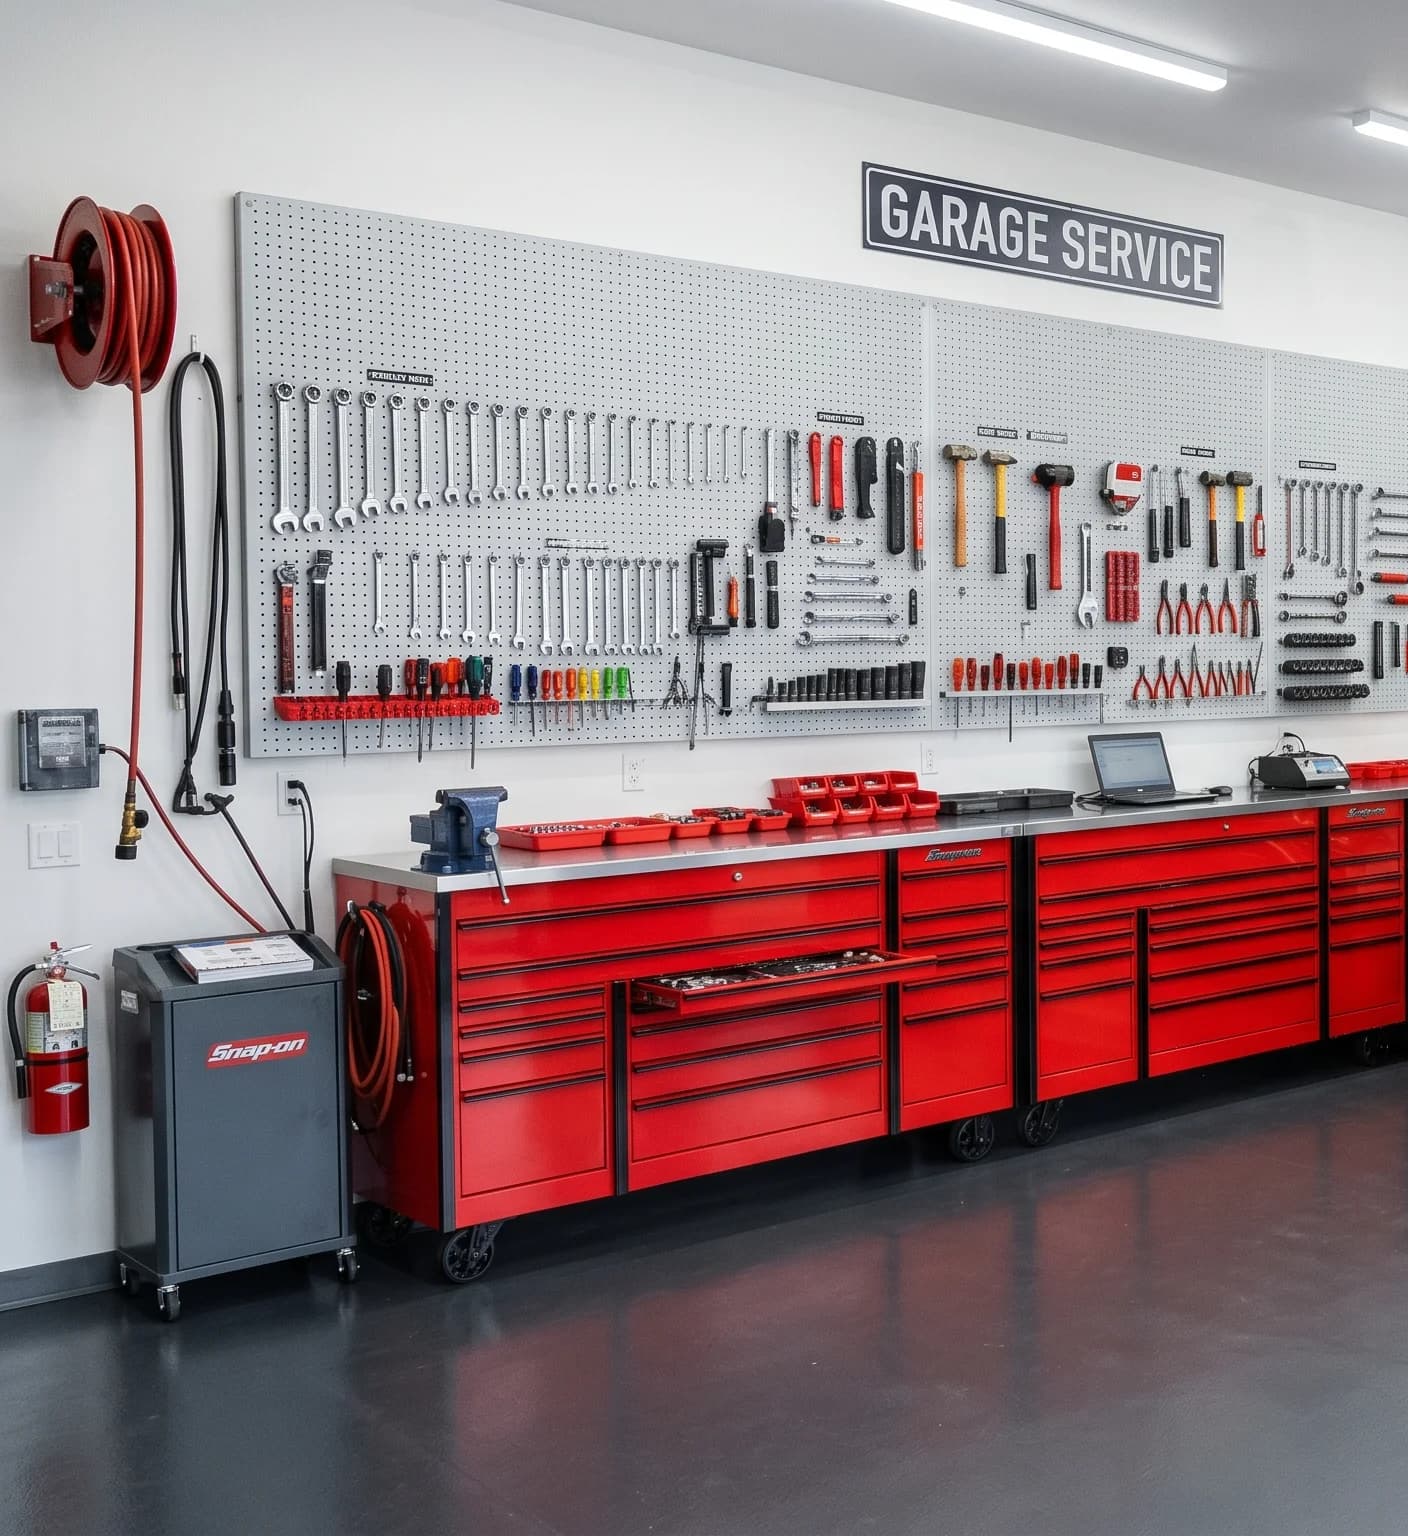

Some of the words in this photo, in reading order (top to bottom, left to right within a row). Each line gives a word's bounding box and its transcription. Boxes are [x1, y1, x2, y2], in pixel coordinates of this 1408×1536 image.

[881, 184, 1049, 264] GARAGE
[1062, 219, 1212, 293] SERVICE
[207, 1039, 306, 1063] Snap-on
